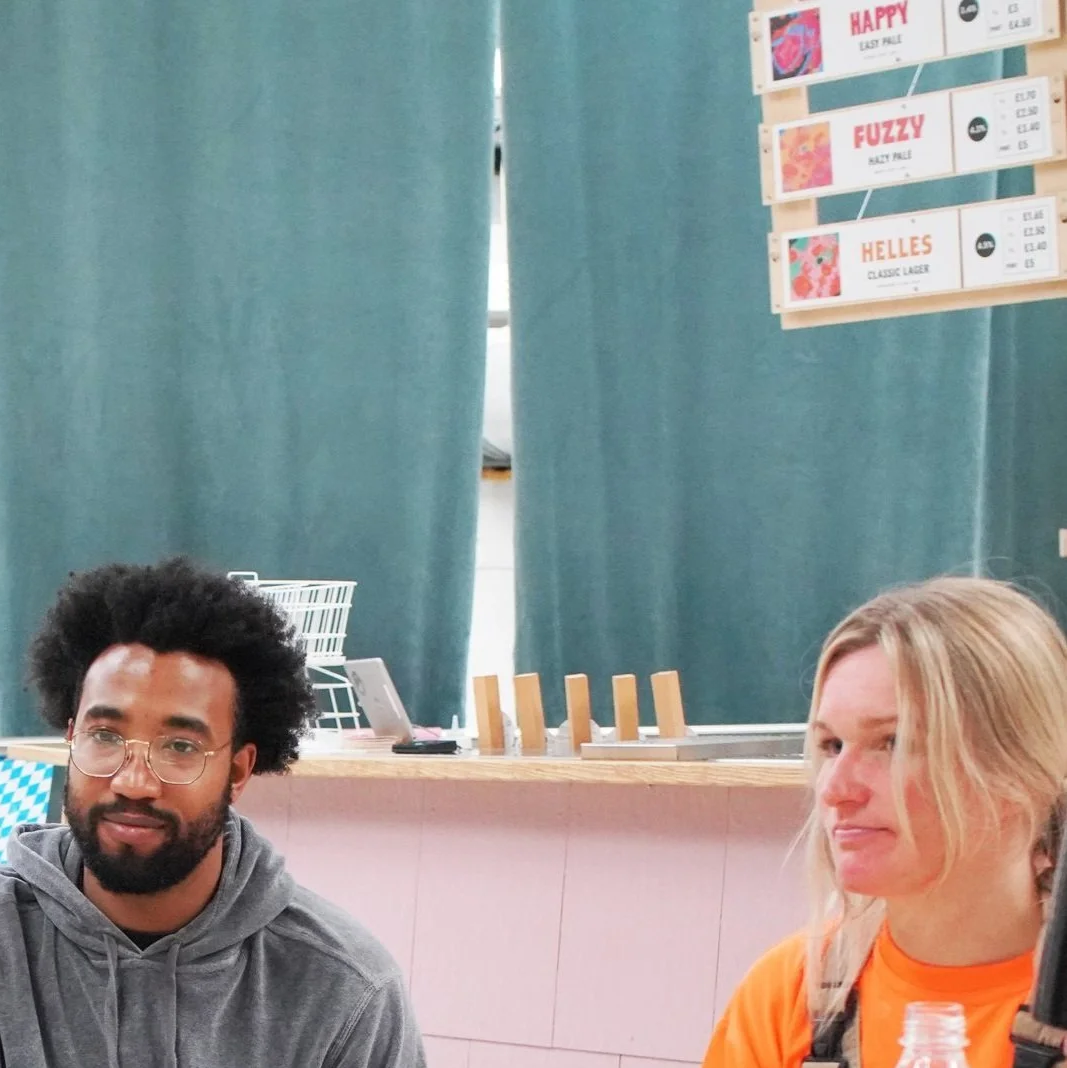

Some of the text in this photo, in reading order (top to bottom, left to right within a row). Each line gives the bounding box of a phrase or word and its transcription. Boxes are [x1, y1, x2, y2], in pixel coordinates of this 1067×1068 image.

[850, 0, 908, 36] HAPPY
[859, 34, 903, 52] EASY PALE
[854, 113, 925, 149] FUZZY
[868, 149, 913, 166] HAZY PALE
[860, 233, 933, 264] HELLES
[867, 263, 931, 281] CLASSIC LAGER
